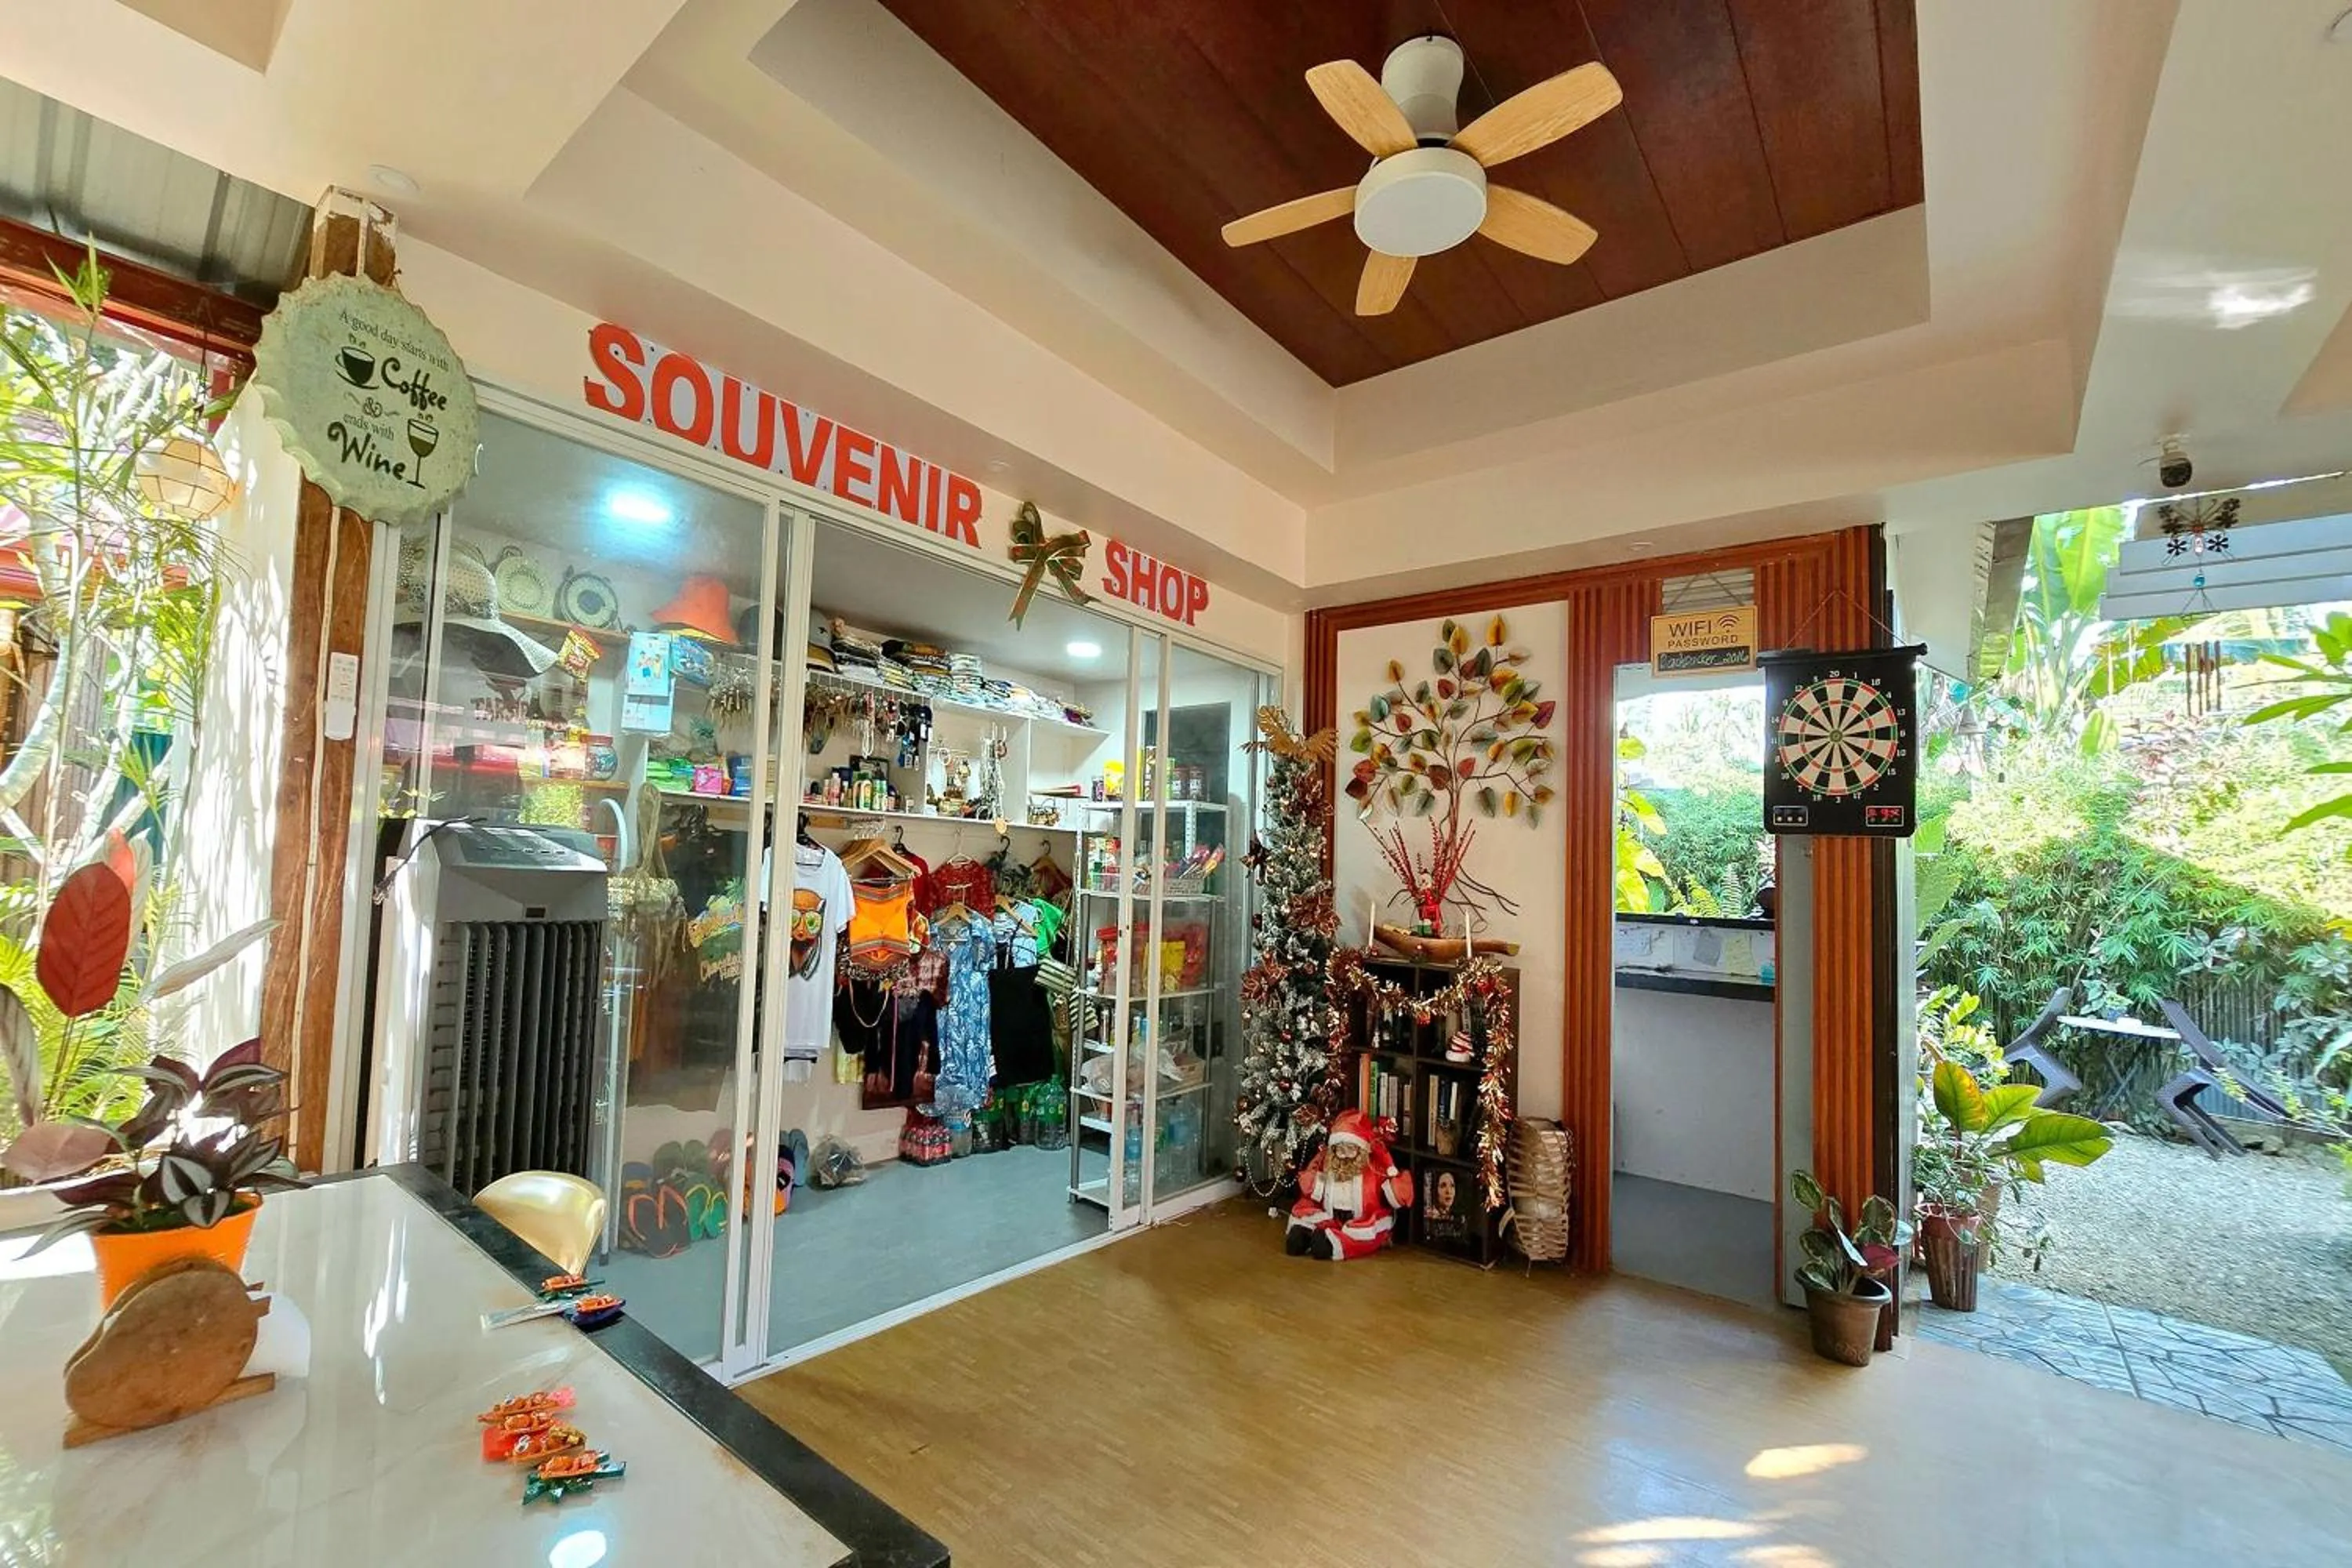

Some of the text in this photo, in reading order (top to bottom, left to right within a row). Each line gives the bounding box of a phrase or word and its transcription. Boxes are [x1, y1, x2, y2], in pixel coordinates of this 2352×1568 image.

[339, 308, 448, 372] A good day starts with
[381, 357, 448, 411] Coffee
[327, 421, 406, 481] Wine
[343, 412, 394, 441] ends with
[584, 322, 1209, 626] SOUVENIR SHOP
[1668, 619, 1711, 637] WIFI
[1668, 634, 1738, 649] PASSWORD
